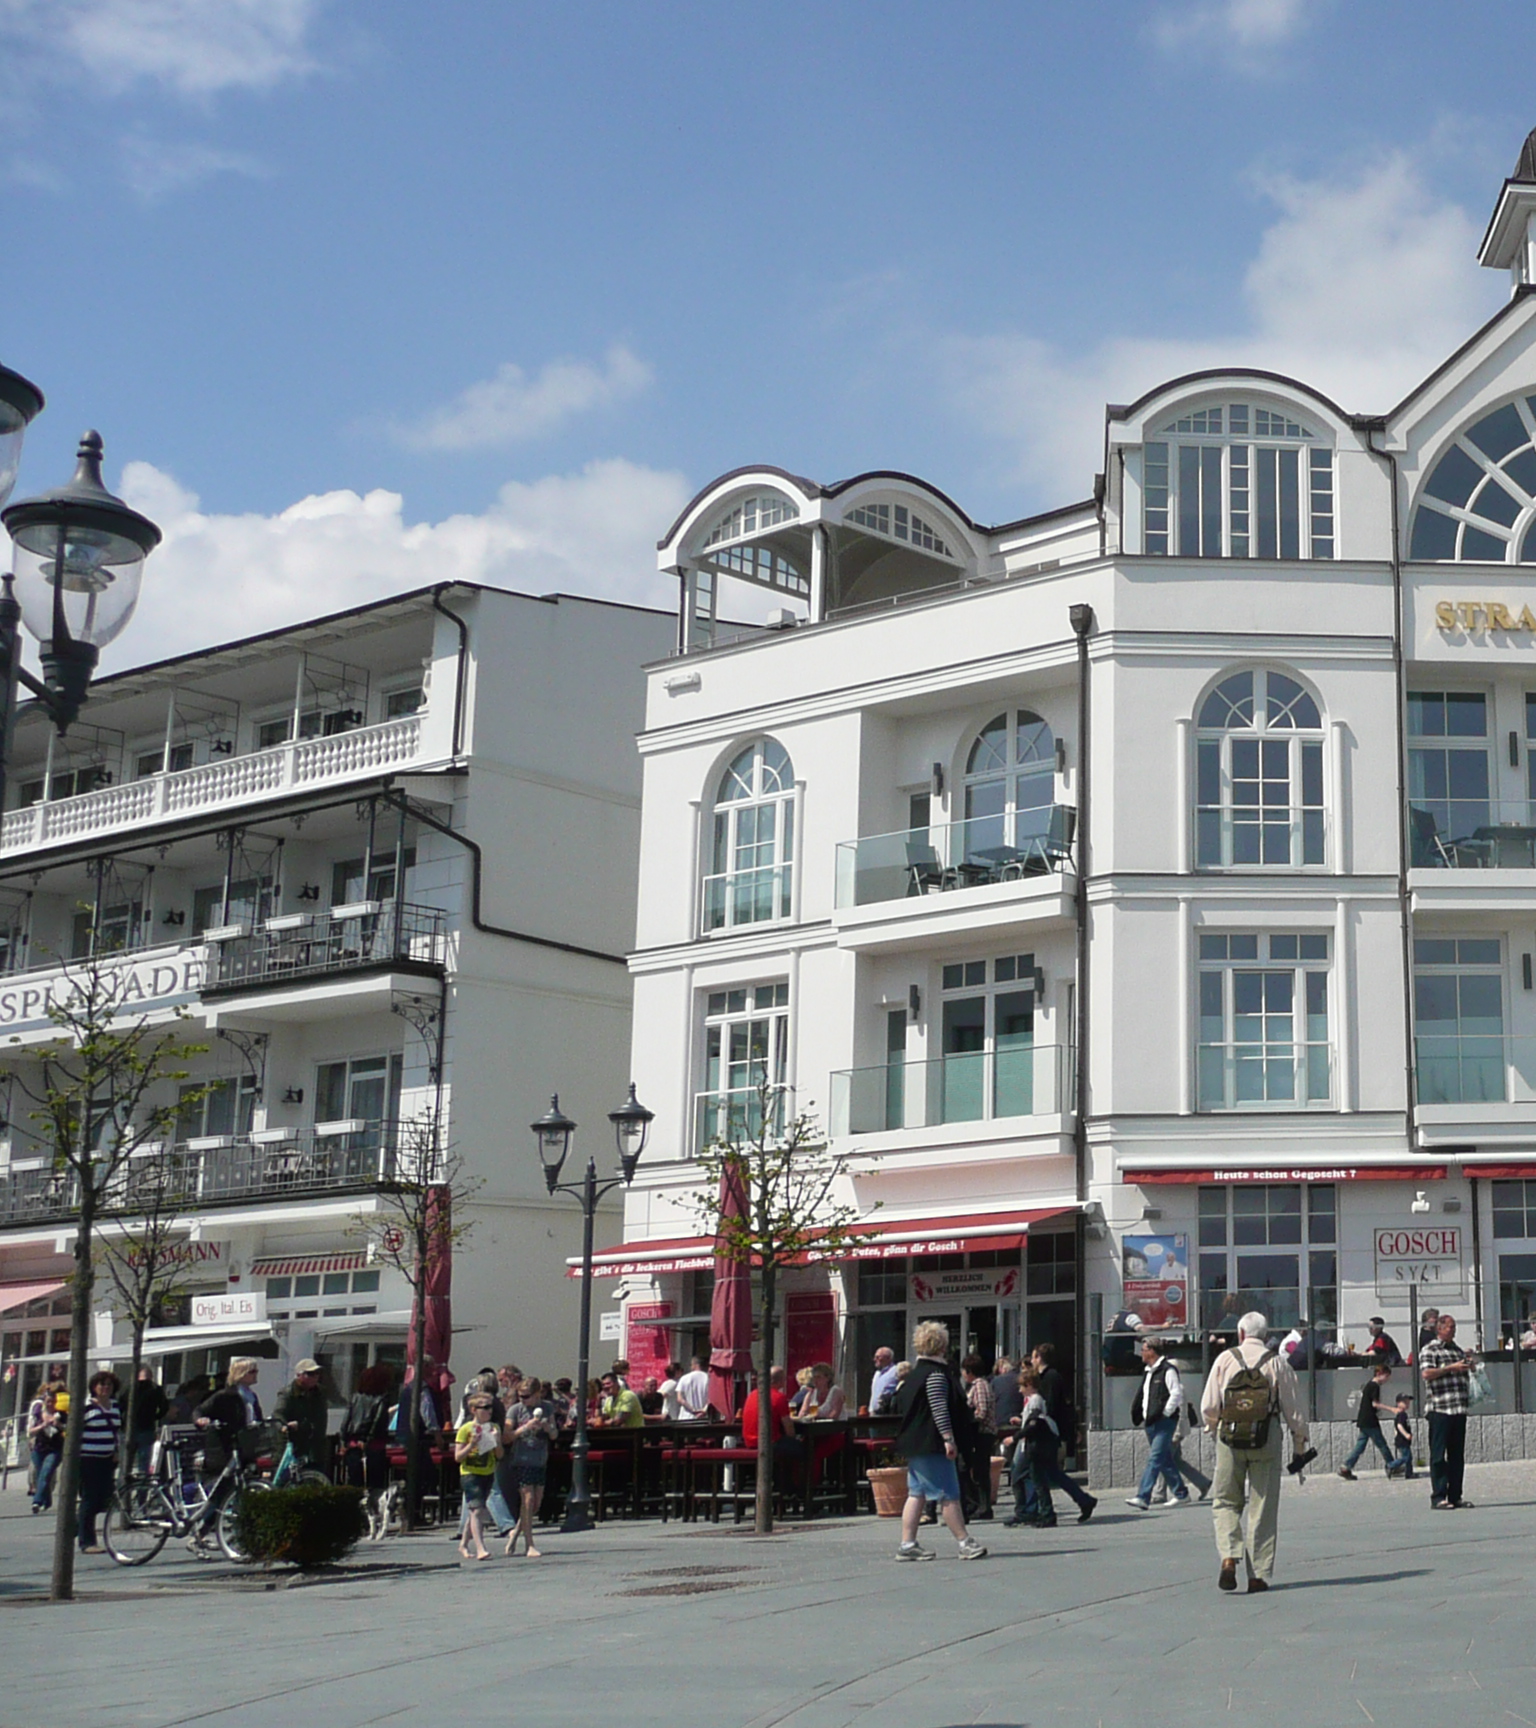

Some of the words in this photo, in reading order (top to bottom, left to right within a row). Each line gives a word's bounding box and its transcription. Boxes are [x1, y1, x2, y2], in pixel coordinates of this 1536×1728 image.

[1214, 1170, 1249, 1180] Heute
[1253, 1170, 1288, 1180] schon
[1291, 1169, 1347, 1181] Gegoscht
[883, 1244, 907, 1257] gönn
[910, 1242, 925, 1253] dir
[928, 1241, 958, 1252] Gosch
[960, 1240, 965, 1250] !
[1378, 1230, 1457, 1256] GOSCH
[621, 1263, 635, 1274] die
[636, 1261, 673, 1273] leckeren
[942, 1273, 984, 1283] HERZLICH
[936, 1283, 992, 1294] WILLKOMMEN
[196, 1303, 218, 1320] Orig.
[221, 1300, 237, 1315] Ital.
[240, 1300, 252, 1314] Eis
